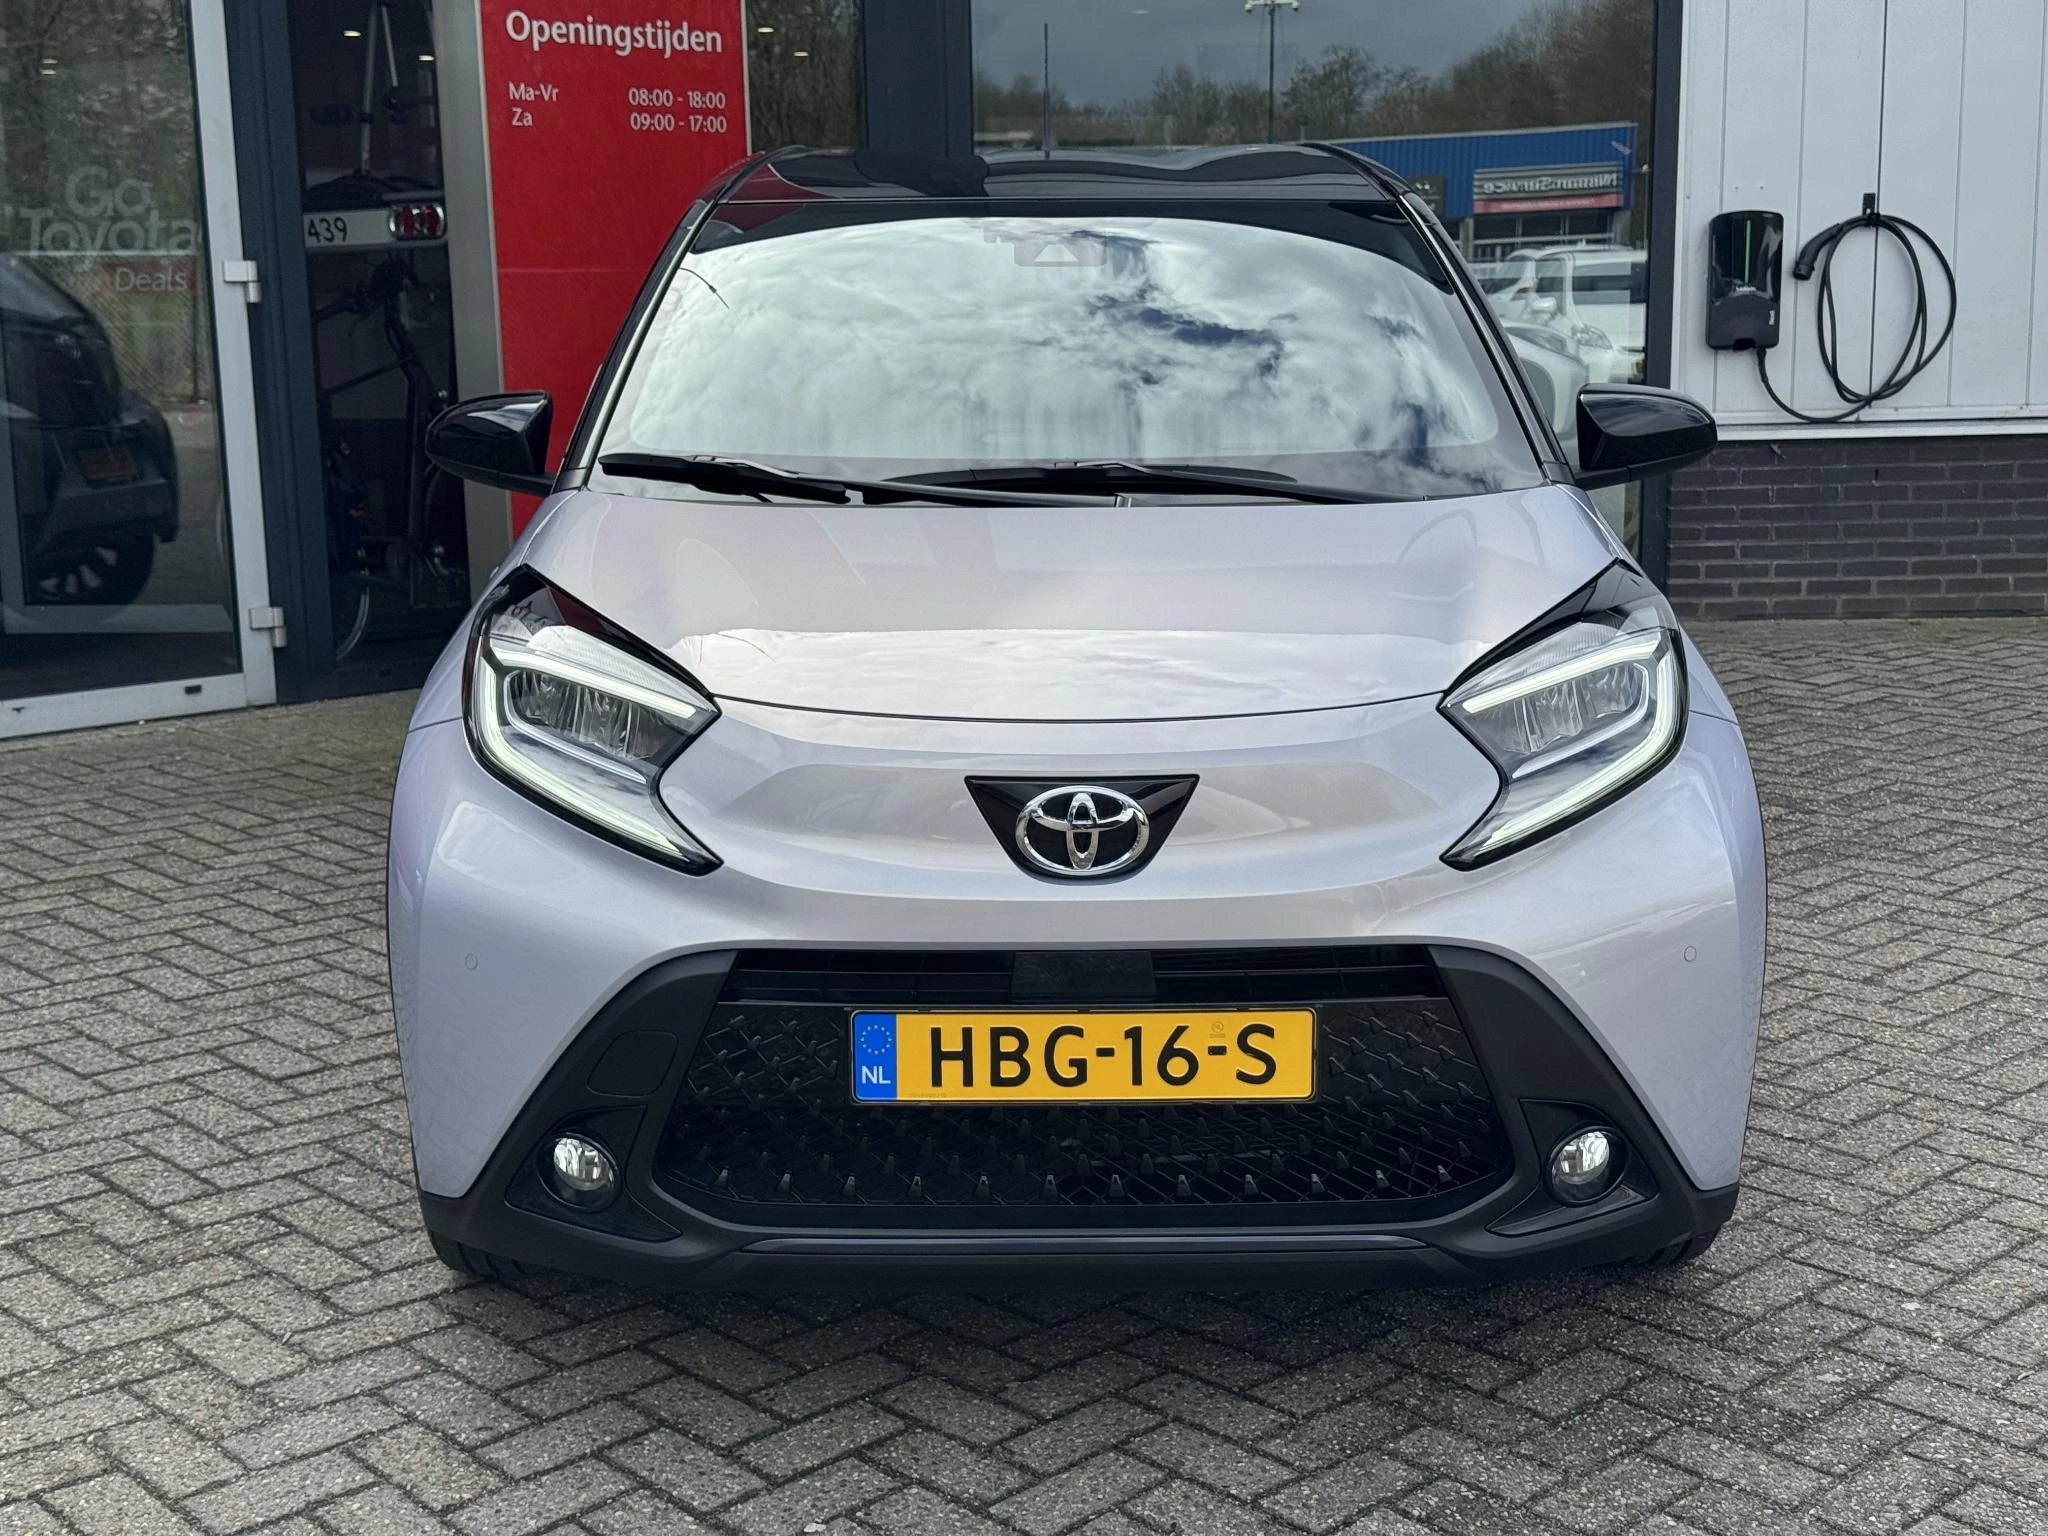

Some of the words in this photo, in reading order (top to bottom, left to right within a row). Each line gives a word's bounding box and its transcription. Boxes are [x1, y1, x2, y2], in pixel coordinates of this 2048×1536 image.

[506, 10, 722, 58] Openingstijden
[508, 82, 559, 102] Ma-Vr
[628, 87, 673, 107] 08:00
[687, 90, 726, 109] 18:00
[511, 107, 533, 126] Za
[630, 112, 675, 131] 09:00
[688, 115, 727, 133] 17:00
[66, 165, 151, 218] Go
[20, 206, 198, 272] Toyota
[307, 217, 348, 242] 439
[115, 267, 188, 292] Deals
[930, 1024, 1277, 1088] HBG-16-S
[861, 1065, 892, 1085] NL
